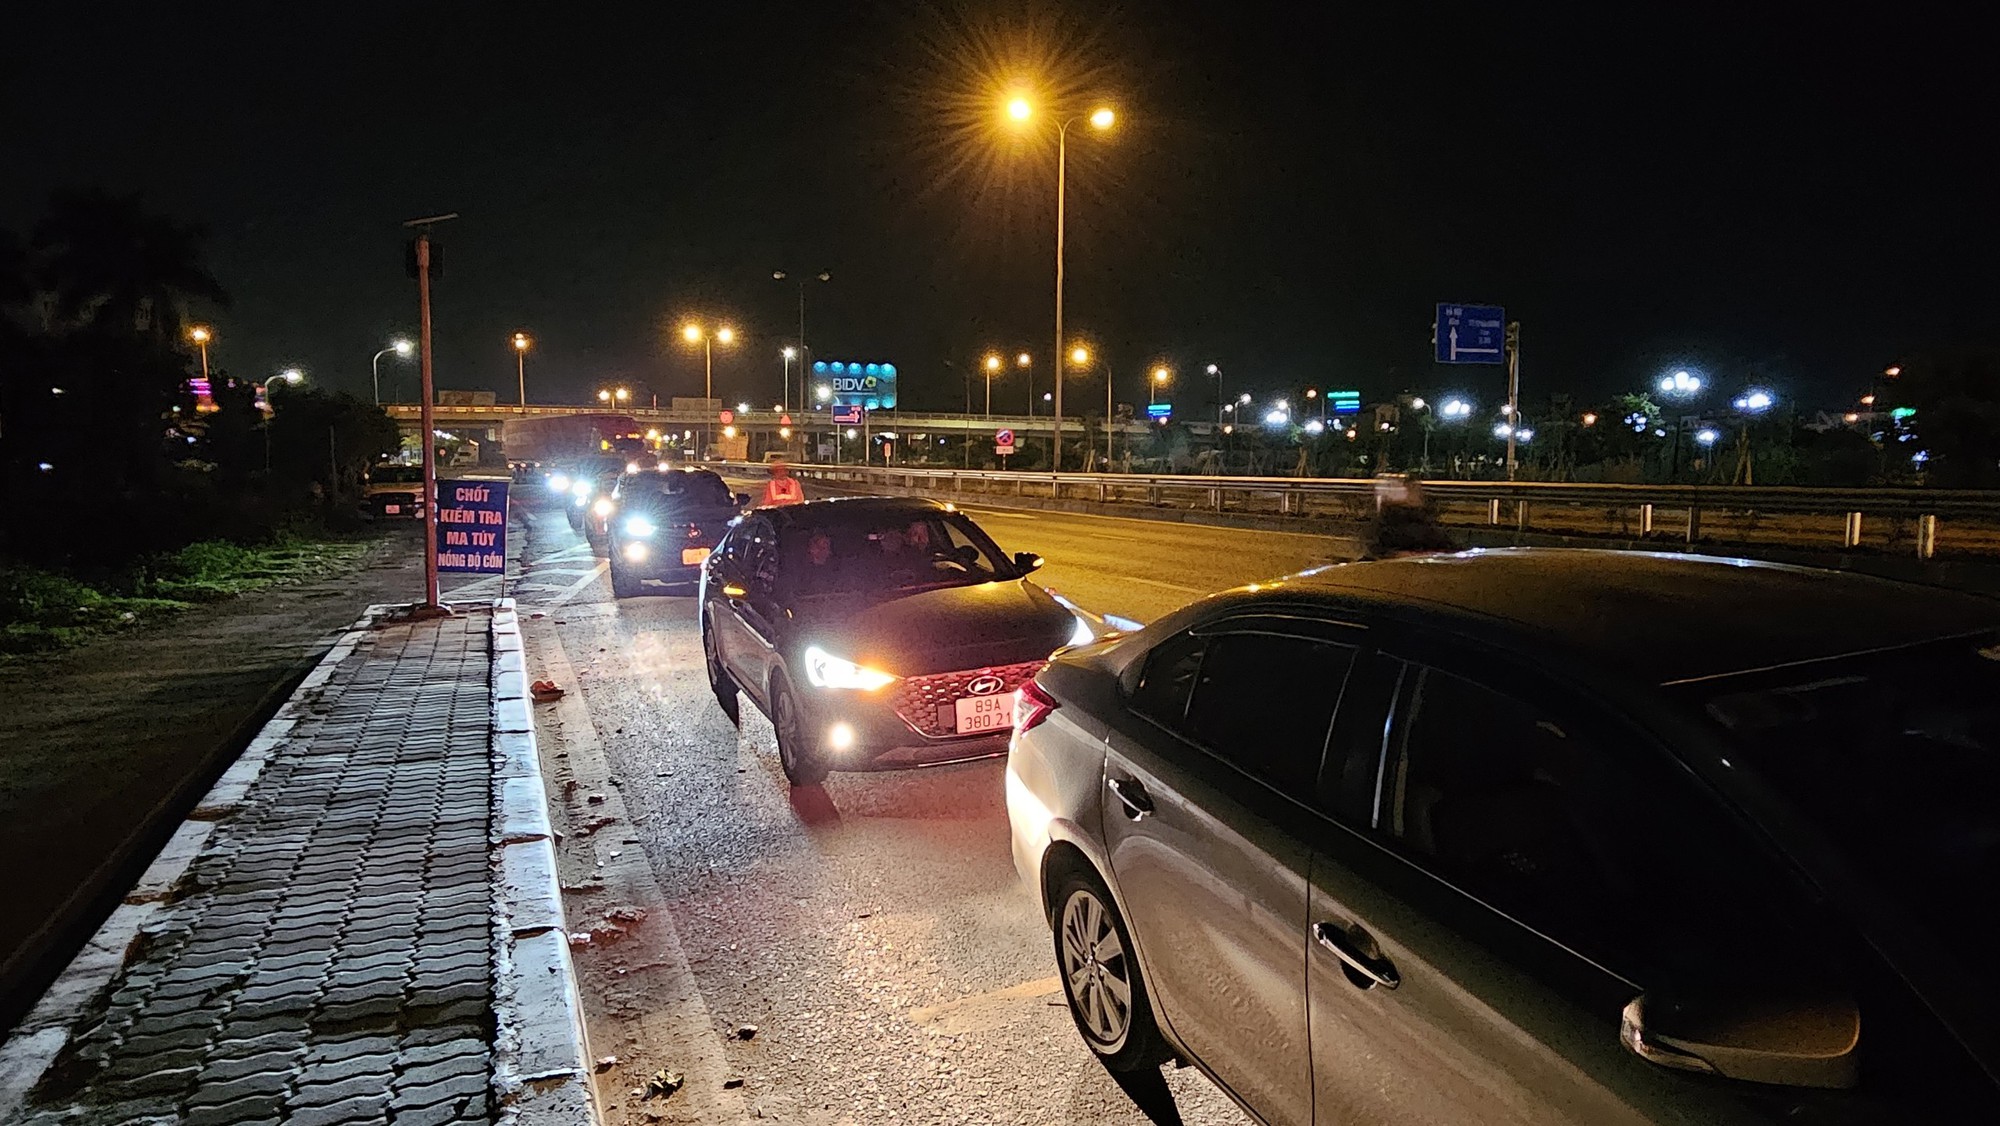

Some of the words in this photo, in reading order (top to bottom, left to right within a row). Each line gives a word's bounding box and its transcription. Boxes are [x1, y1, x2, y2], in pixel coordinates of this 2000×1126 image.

[832, 378, 864, 391] BIDV
[456, 485, 490, 502] CHỐT
[441, 506, 475, 523] KIỂM
[478, 510, 503, 525] TRA
[446, 531, 468, 546] MA
[471, 530, 496, 546] TÚY
[467, 552, 481, 570] ĐỘ
[975, 698, 1001, 713] 89A
[965, 712, 1011, 730] 380.21
